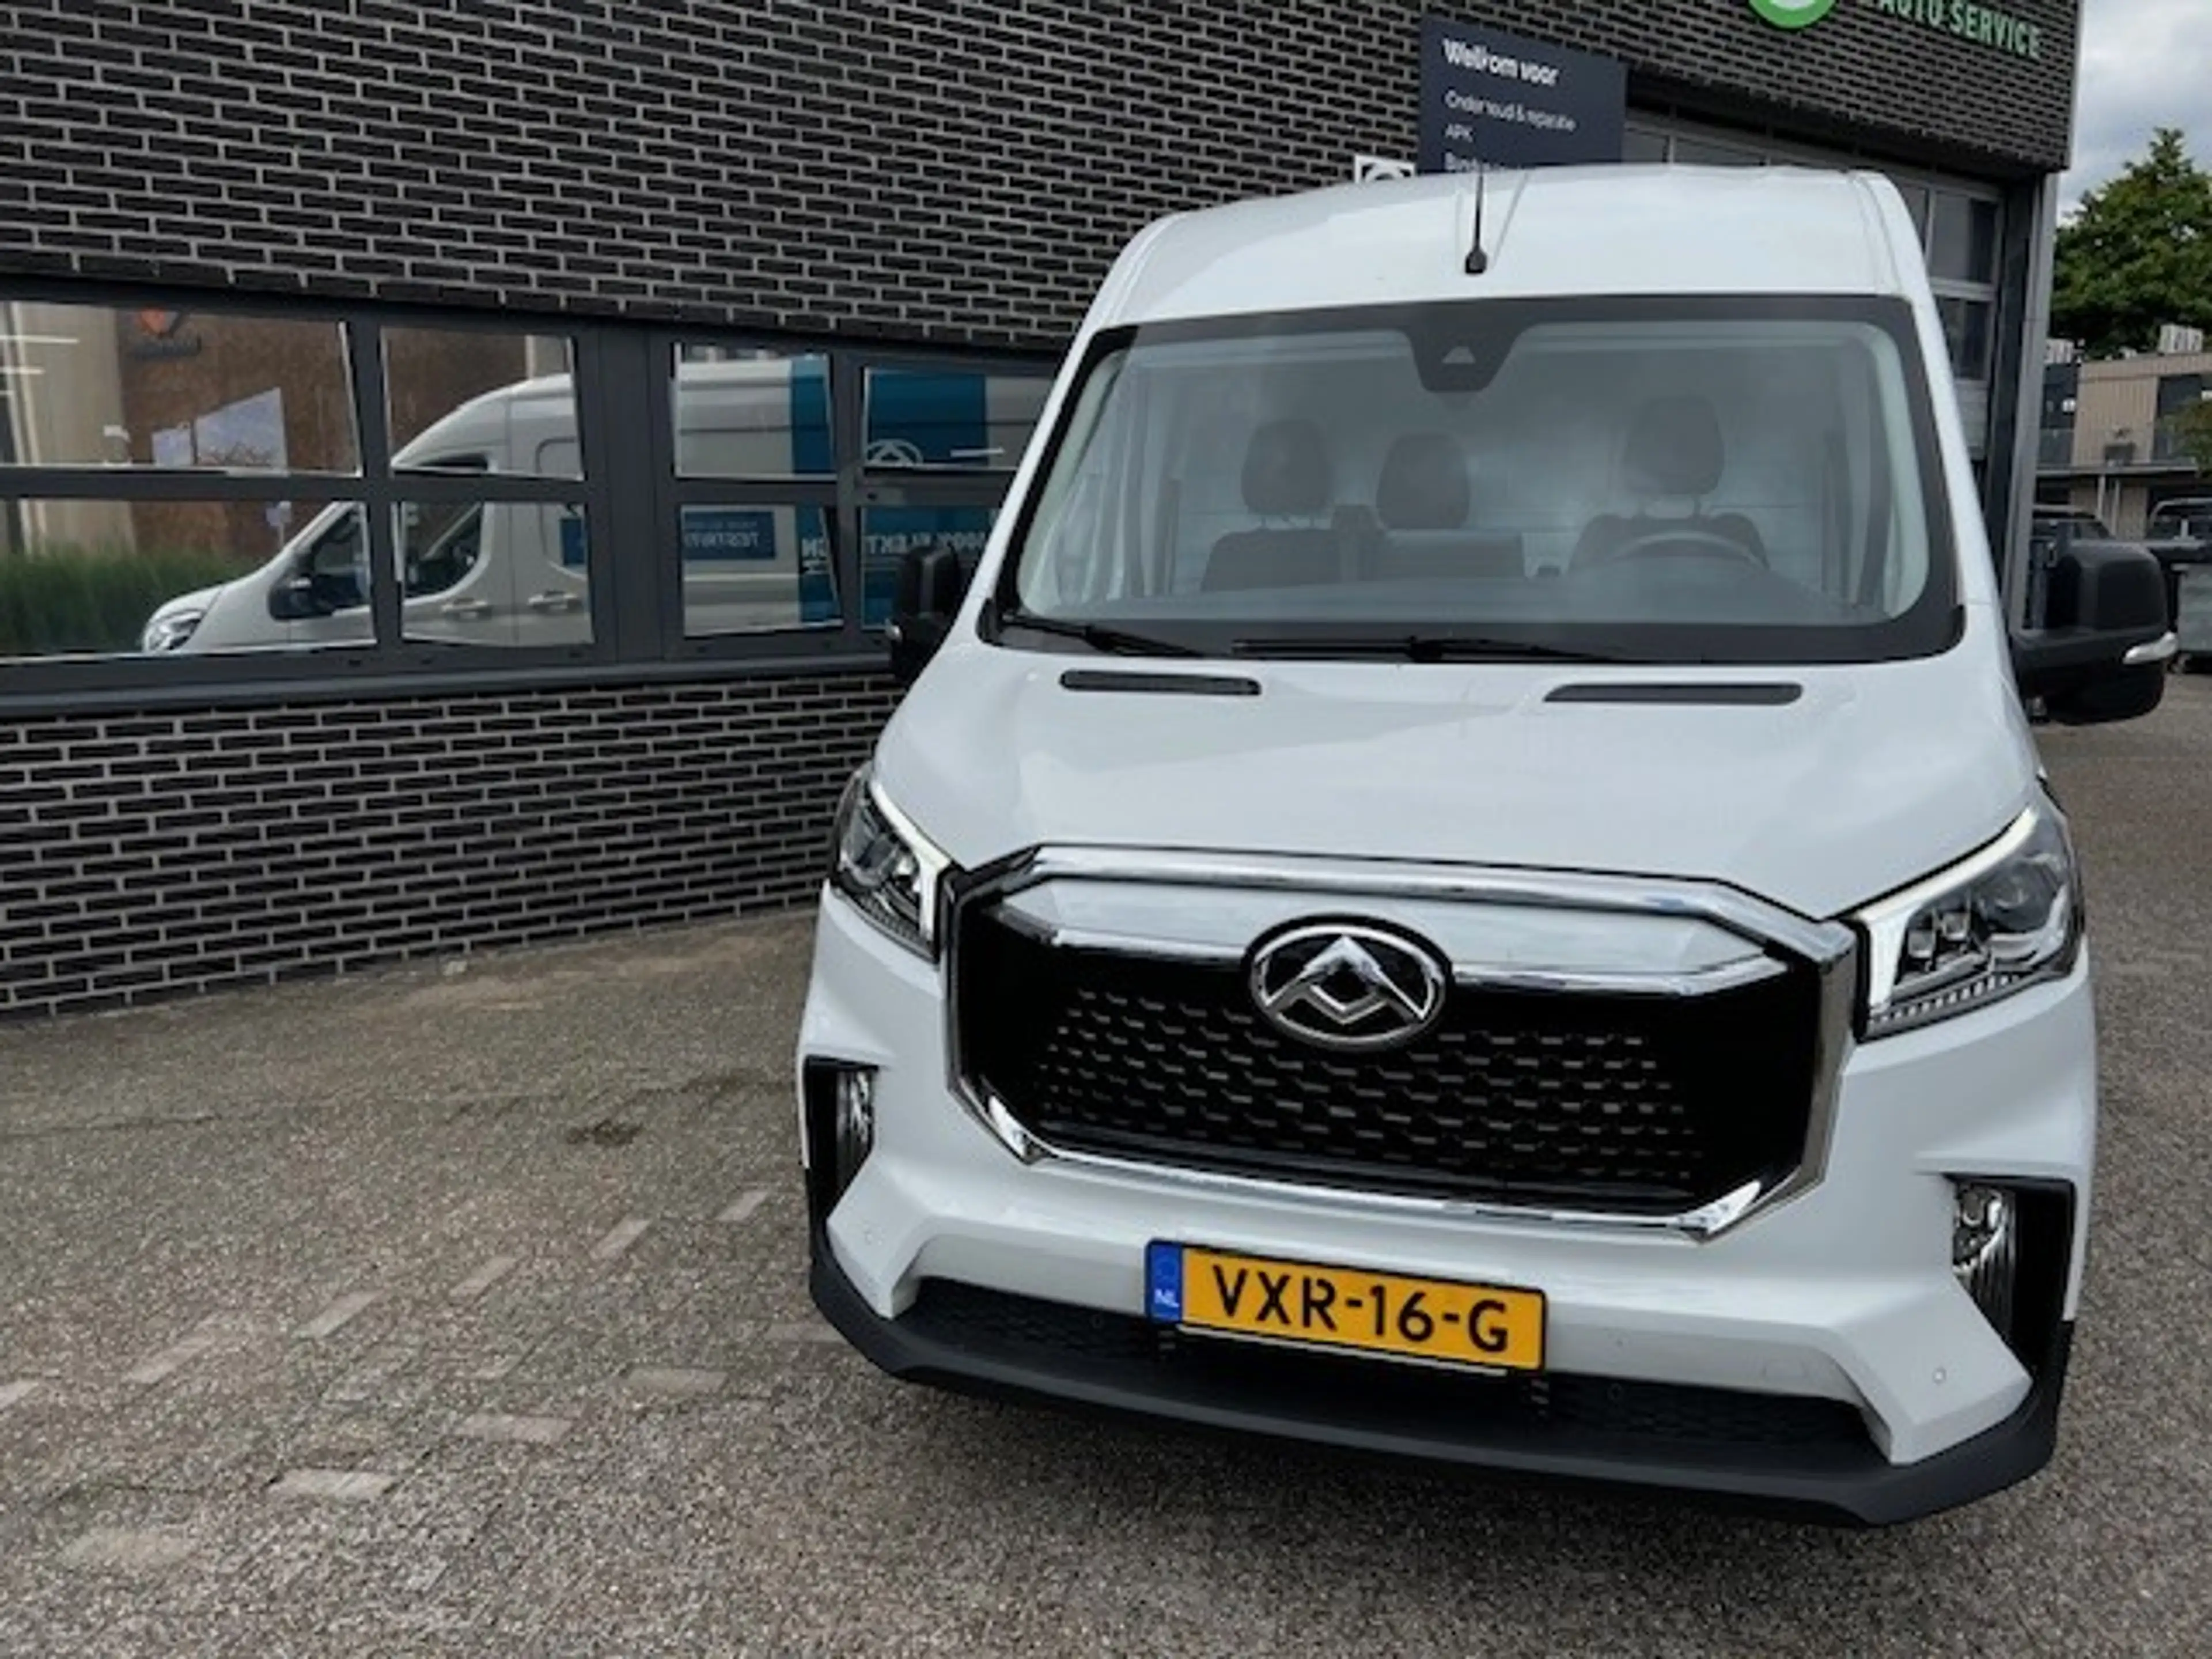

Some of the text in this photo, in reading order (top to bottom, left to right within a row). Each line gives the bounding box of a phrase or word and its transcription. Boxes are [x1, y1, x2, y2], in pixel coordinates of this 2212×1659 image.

[1949, 0, 2040, 58] SERVICE
[1442, 37, 1559, 86] Welkom voor
[1445, 124, 1474, 142] APK
[1154, 1288, 1180, 1308] NL
[1212, 1265, 1508, 1353] VXR-16-G
